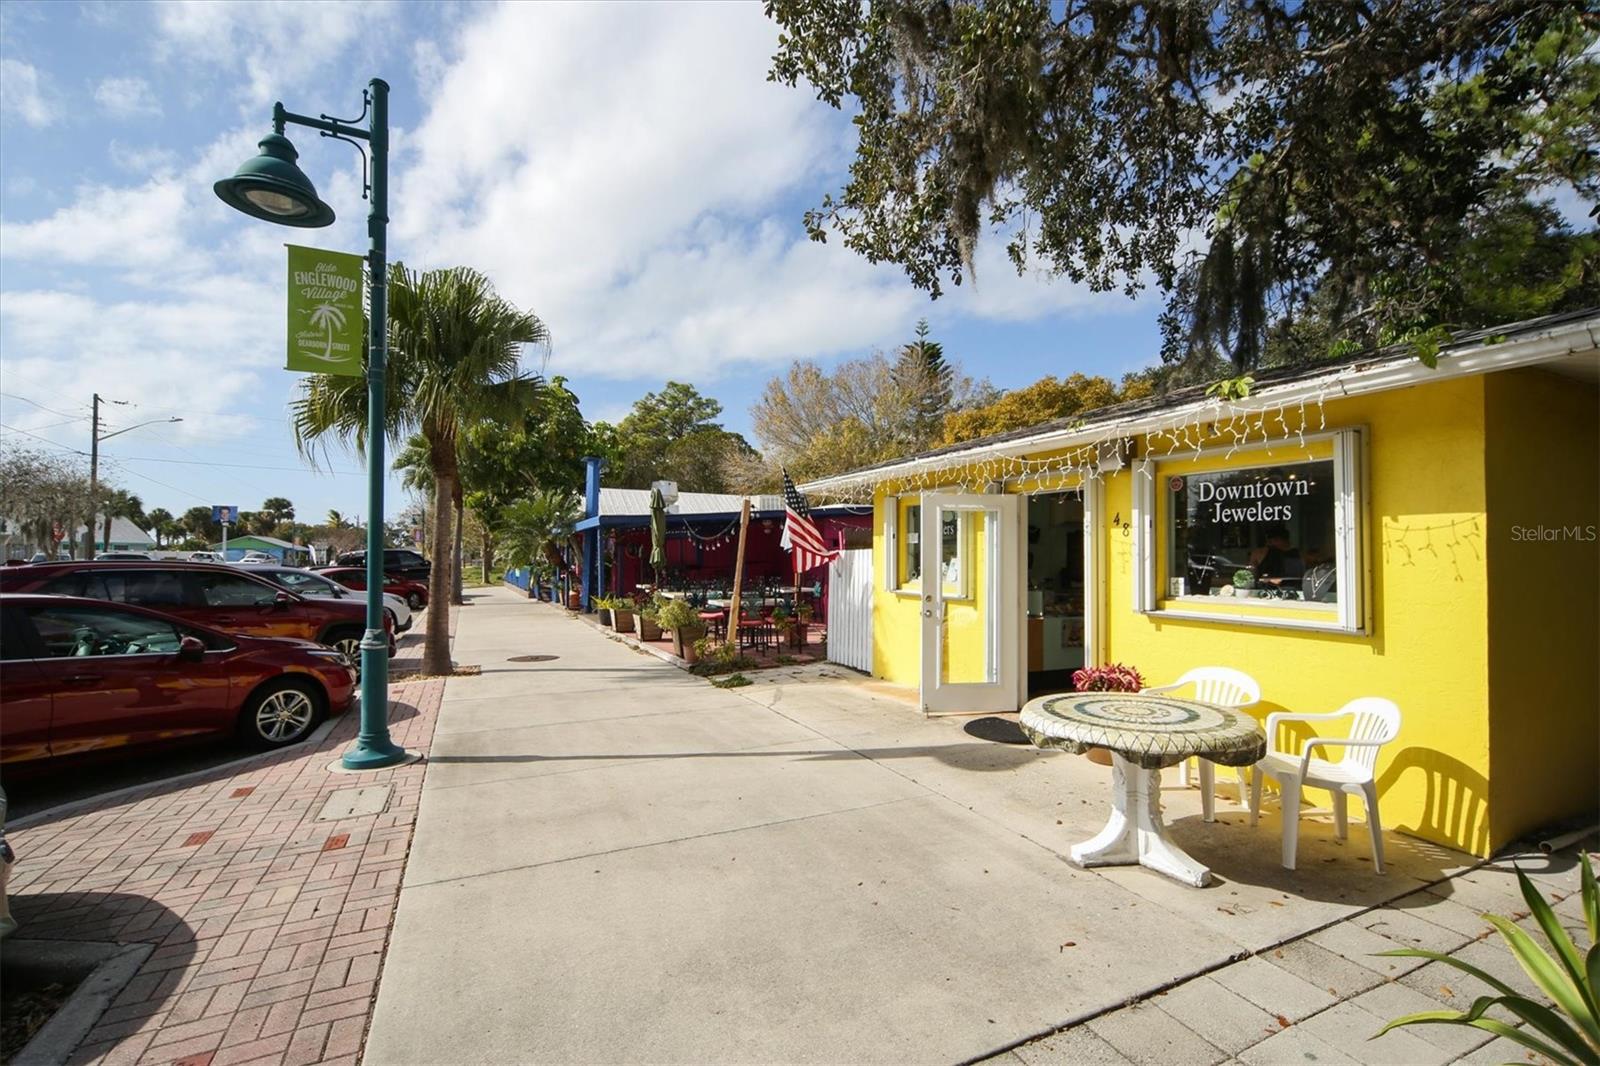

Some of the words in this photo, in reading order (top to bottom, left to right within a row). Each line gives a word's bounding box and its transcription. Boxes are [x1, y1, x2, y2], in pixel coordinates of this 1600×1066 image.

[316, 262, 336, 272] Olde
[295, 272, 356, 292] ENGLEWOOD
[301, 287, 347, 302] Village
[1199, 479, 1309, 502] Downtown
[1212, 501, 1292, 523] Jewelers
[1113, 512, 1130, 537] 48
